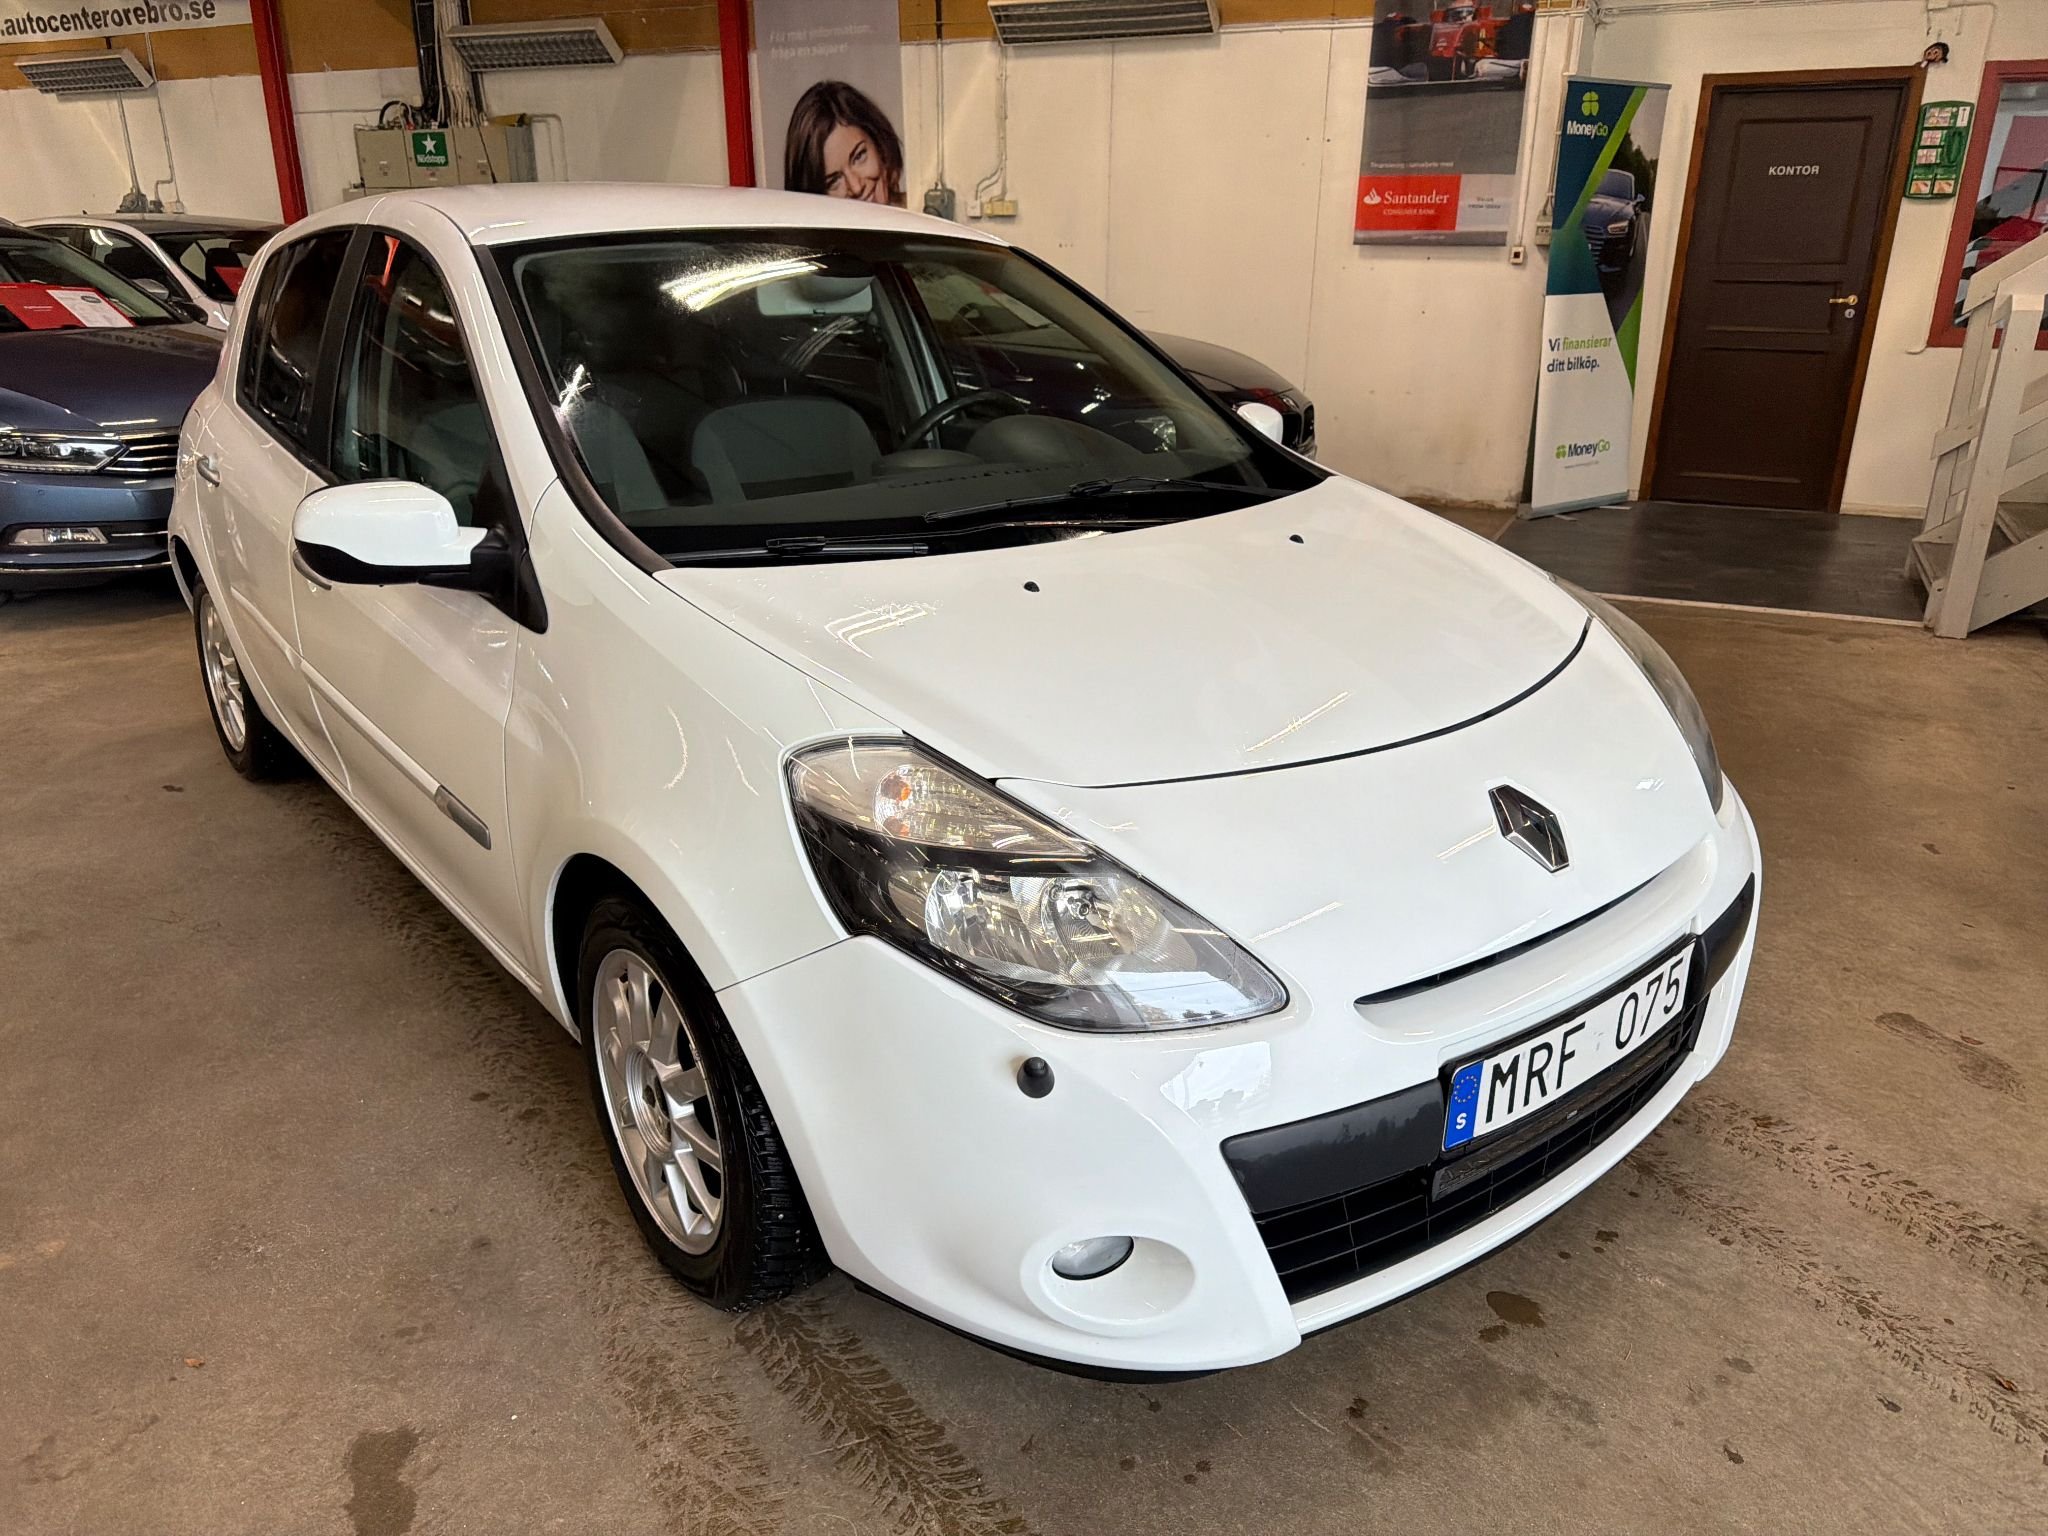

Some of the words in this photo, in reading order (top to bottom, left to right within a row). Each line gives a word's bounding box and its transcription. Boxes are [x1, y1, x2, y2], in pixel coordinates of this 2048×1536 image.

[1567, 120, 1609, 139] MoneyGo
[1768, 165, 1820, 176] KONTOR
[1383, 189, 1450, 204] Santander
[1548, 338, 1561, 352] Vi
[1563, 335, 1613, 351] finansierar
[1546, 358, 1565, 372] ditt
[1567, 356, 1601, 373] bilköp.
[1567, 439, 1611, 458] MoneyGo
[1455, 1112, 1467, 1131] S
[1485, 1021, 1587, 1124] MRF
[1615, 957, 1685, 1051] 075
